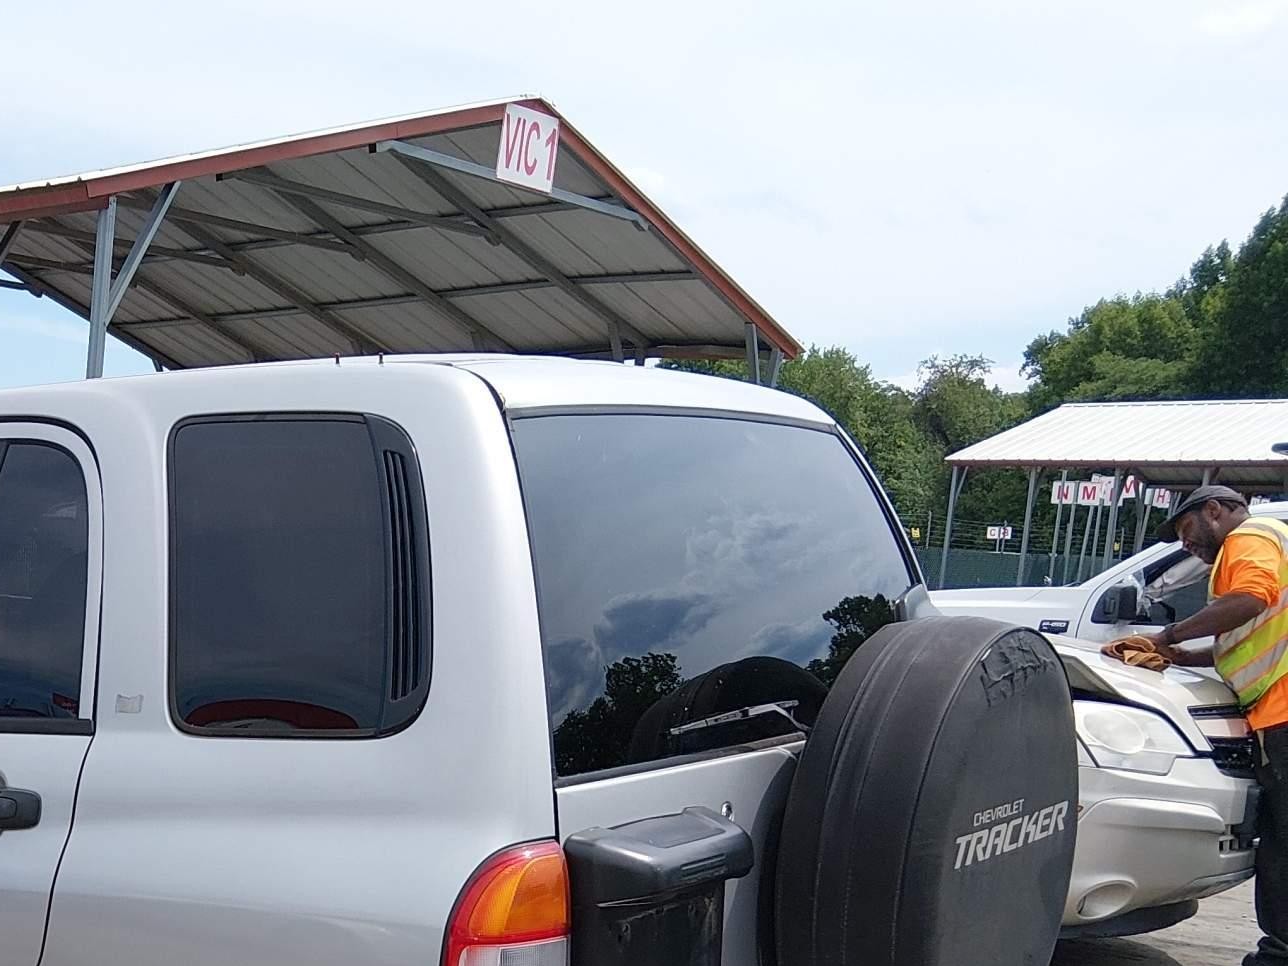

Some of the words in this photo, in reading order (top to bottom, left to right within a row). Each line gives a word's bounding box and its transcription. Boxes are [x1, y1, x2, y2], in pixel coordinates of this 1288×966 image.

[505, 113, 540, 176] VIC
[545, 127, 557, 181] 1
[1057, 485, 1069, 500] N
[1082, 485, 1097, 501] M
[1157, 492, 1166, 504] H
[973, 798, 1025, 827] CHEVROLET
[954, 800, 1069, 870] TRACKER
